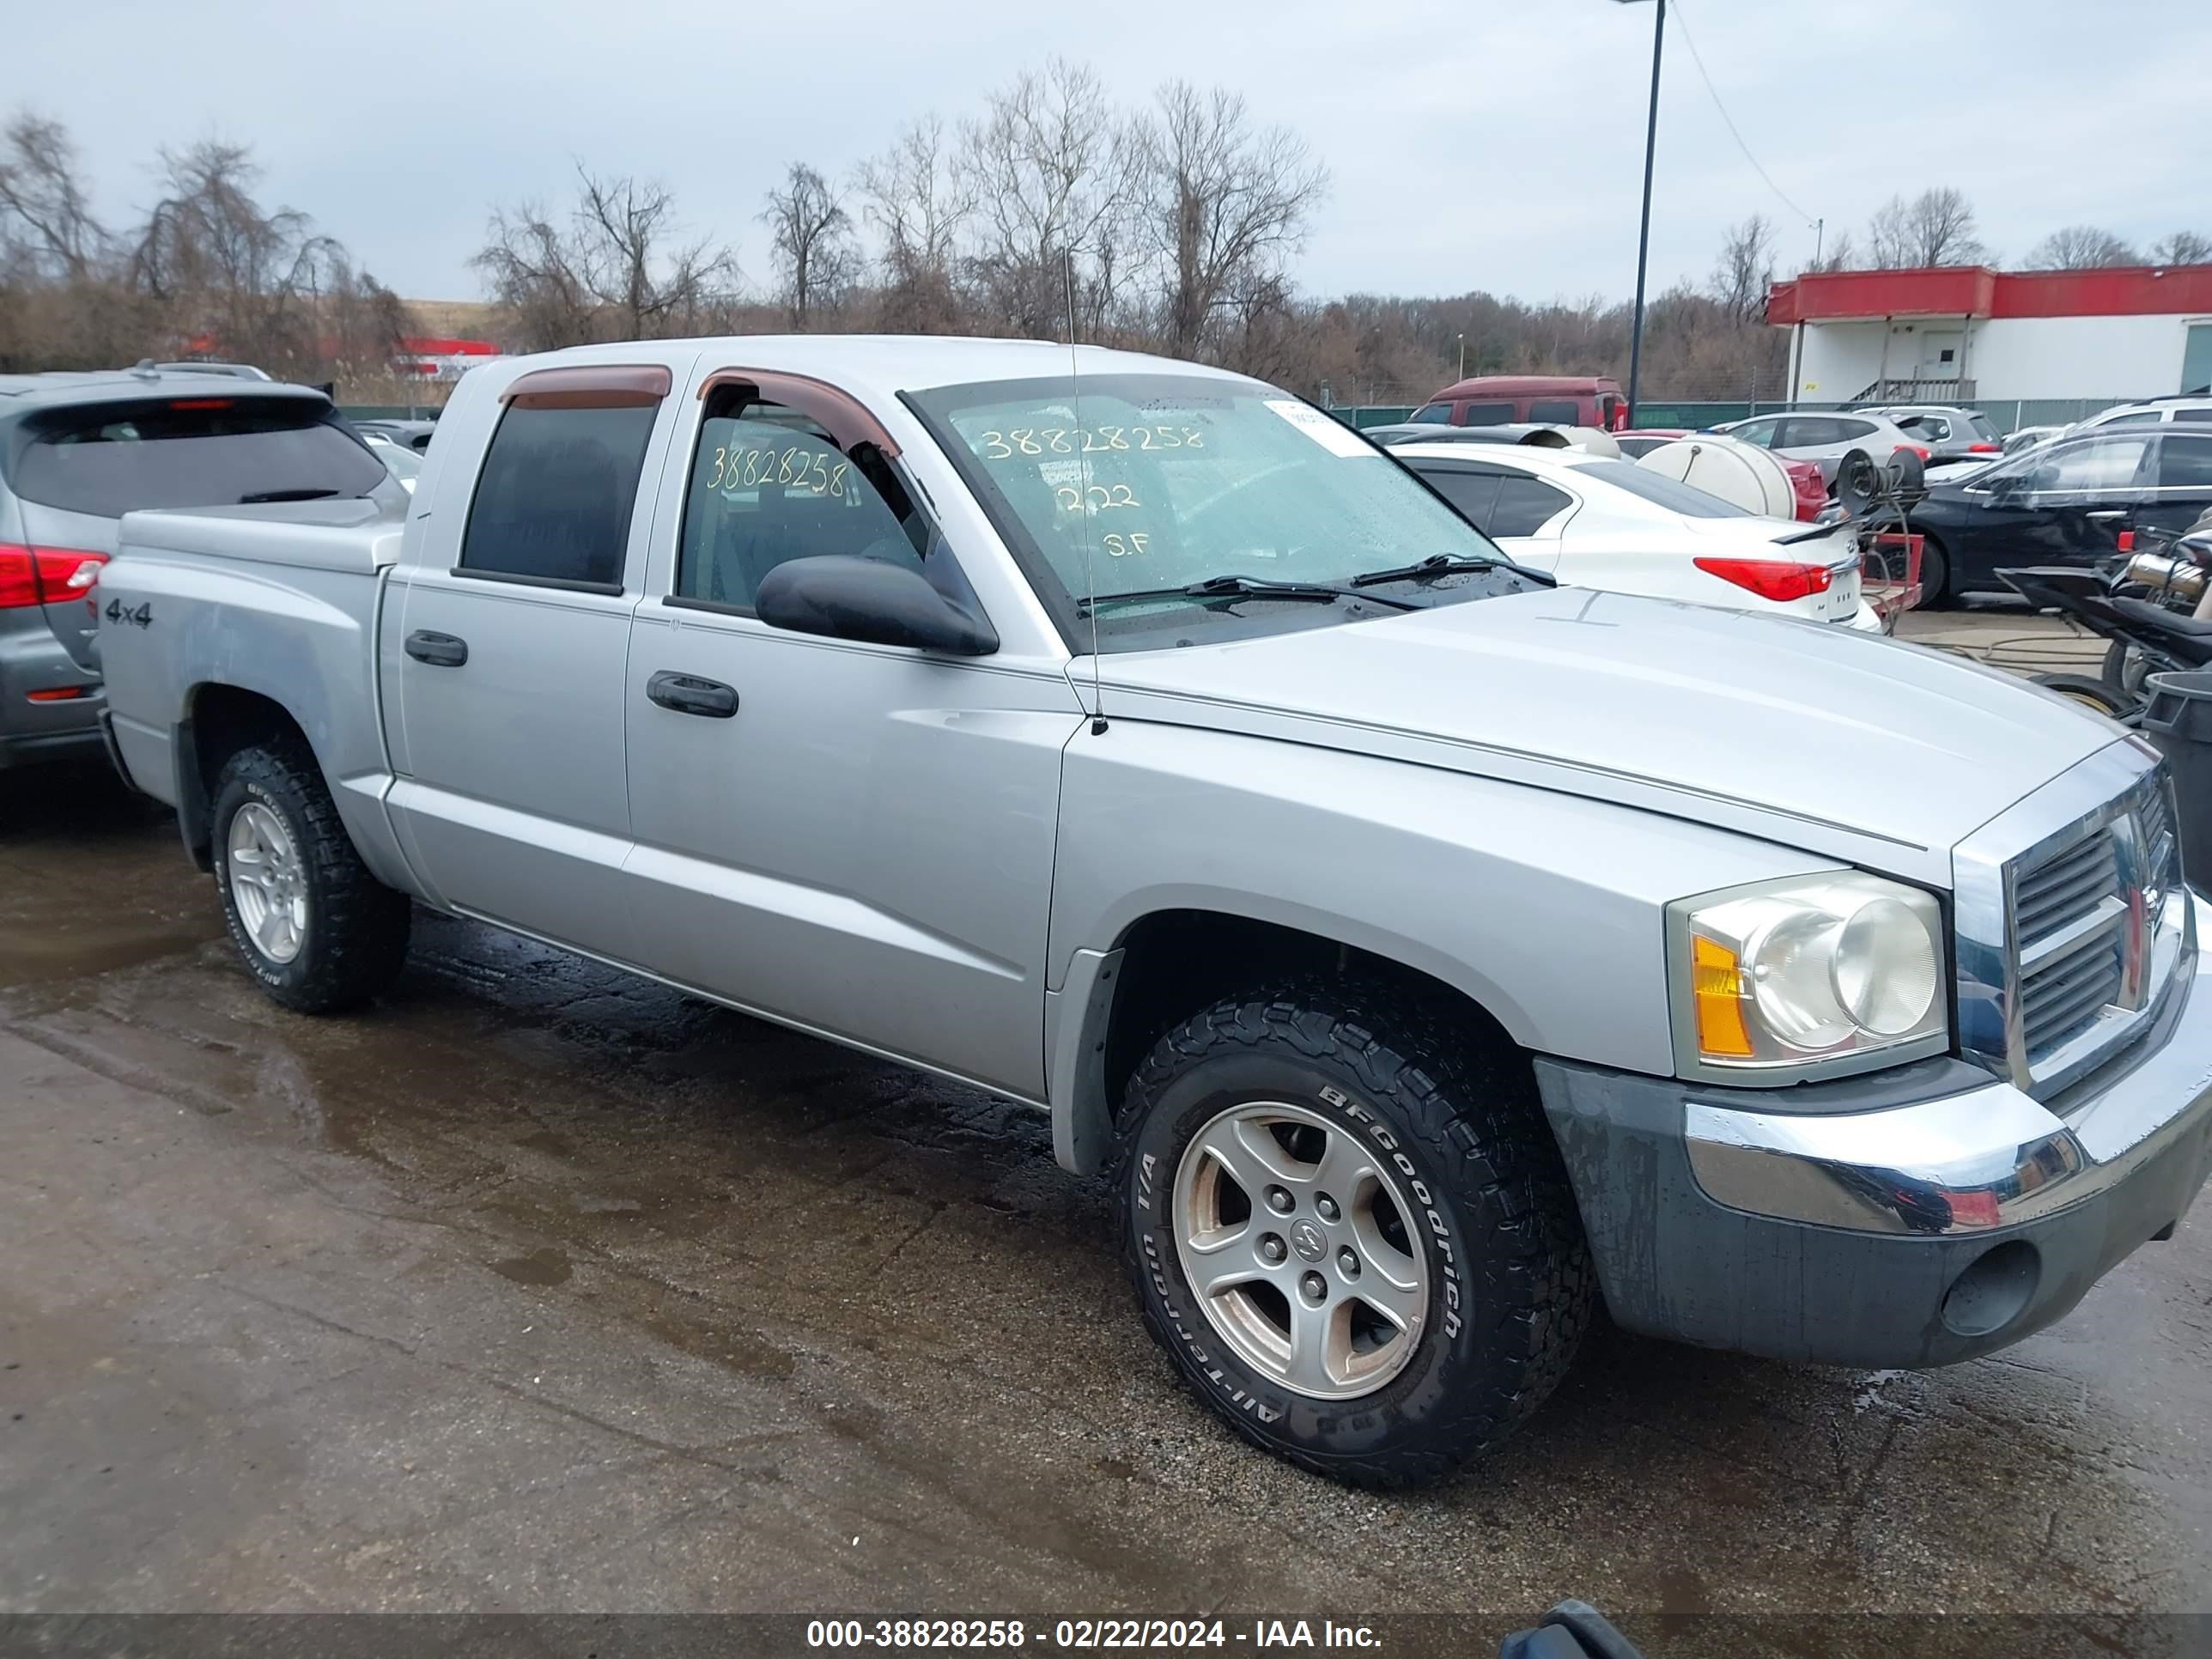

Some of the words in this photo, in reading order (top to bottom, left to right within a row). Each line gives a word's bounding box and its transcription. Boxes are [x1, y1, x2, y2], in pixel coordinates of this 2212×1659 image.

[707, 447, 848, 497] 38828258
[981, 426, 1205, 459] 38828258
[1137, 1152, 1157, 1211] T/A
[1319, 1085, 1462, 1339] BFGoodrich
[1142, 1233, 1284, 1424] All-Terrain
